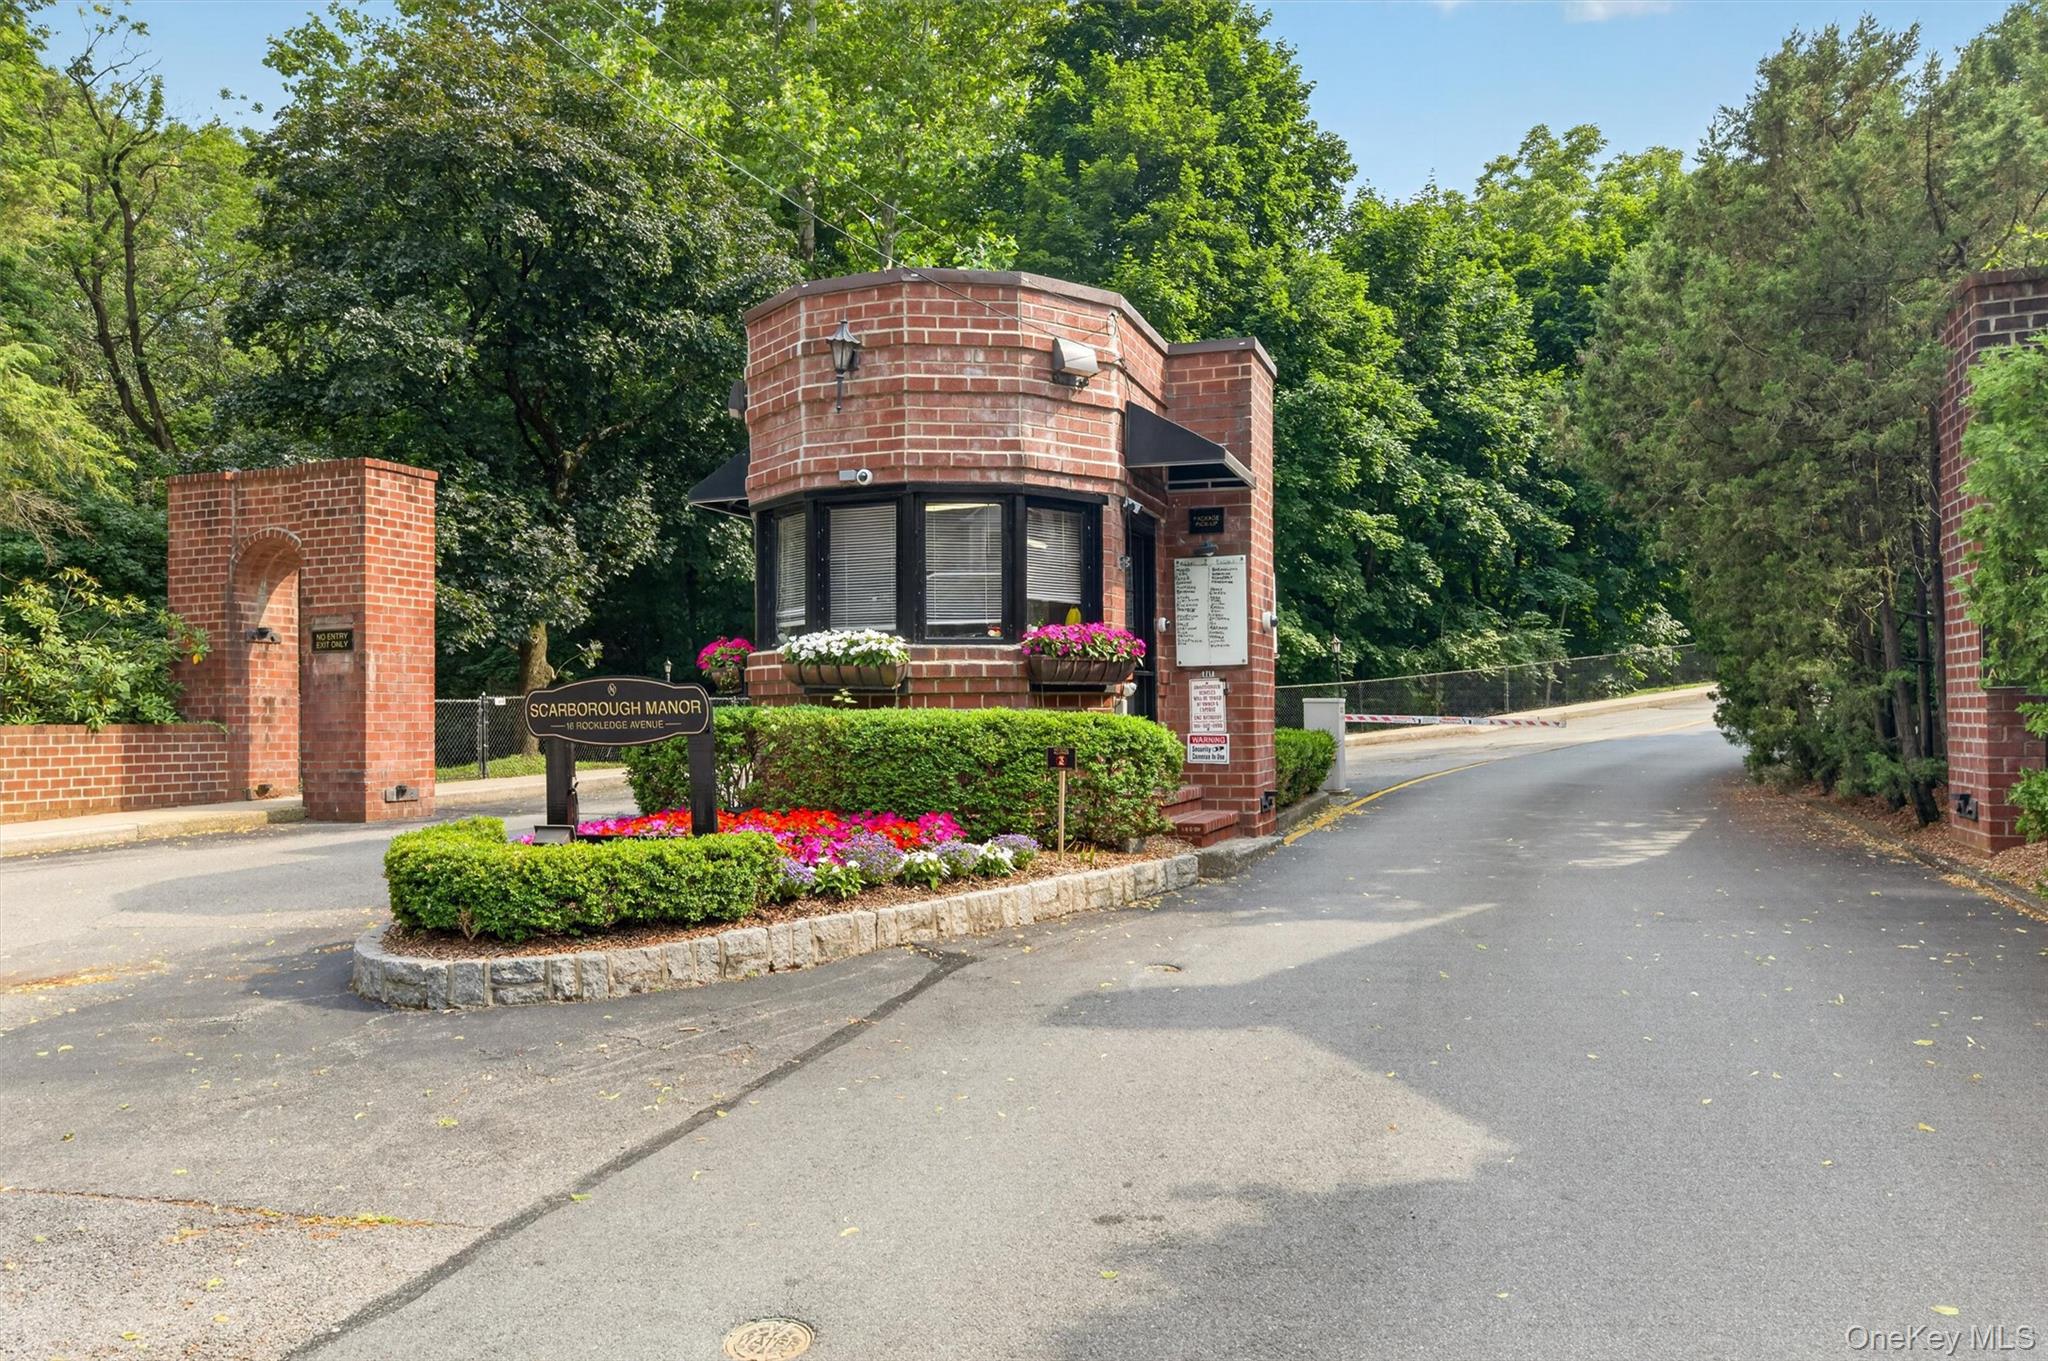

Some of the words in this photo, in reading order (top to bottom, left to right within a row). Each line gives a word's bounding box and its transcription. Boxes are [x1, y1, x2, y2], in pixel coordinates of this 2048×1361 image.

[316, 633, 326, 641] NO
[327, 632, 349, 640] ENTRY
[316, 641, 330, 649] EXIT
[330, 640, 349, 648] ONLY
[530, 701, 641, 718] SCARBOROUGH
[645, 699, 702, 715] MANOR
[566, 721, 575, 730] 16
[576, 720, 628, 730] ROCKLEDGE
[629, 719, 664, 729] AVENUE
[1191, 736, 1226, 744] WARNING
[1192, 745, 1211, 753] Security
[738, 1331, 801, 1348] WATER
